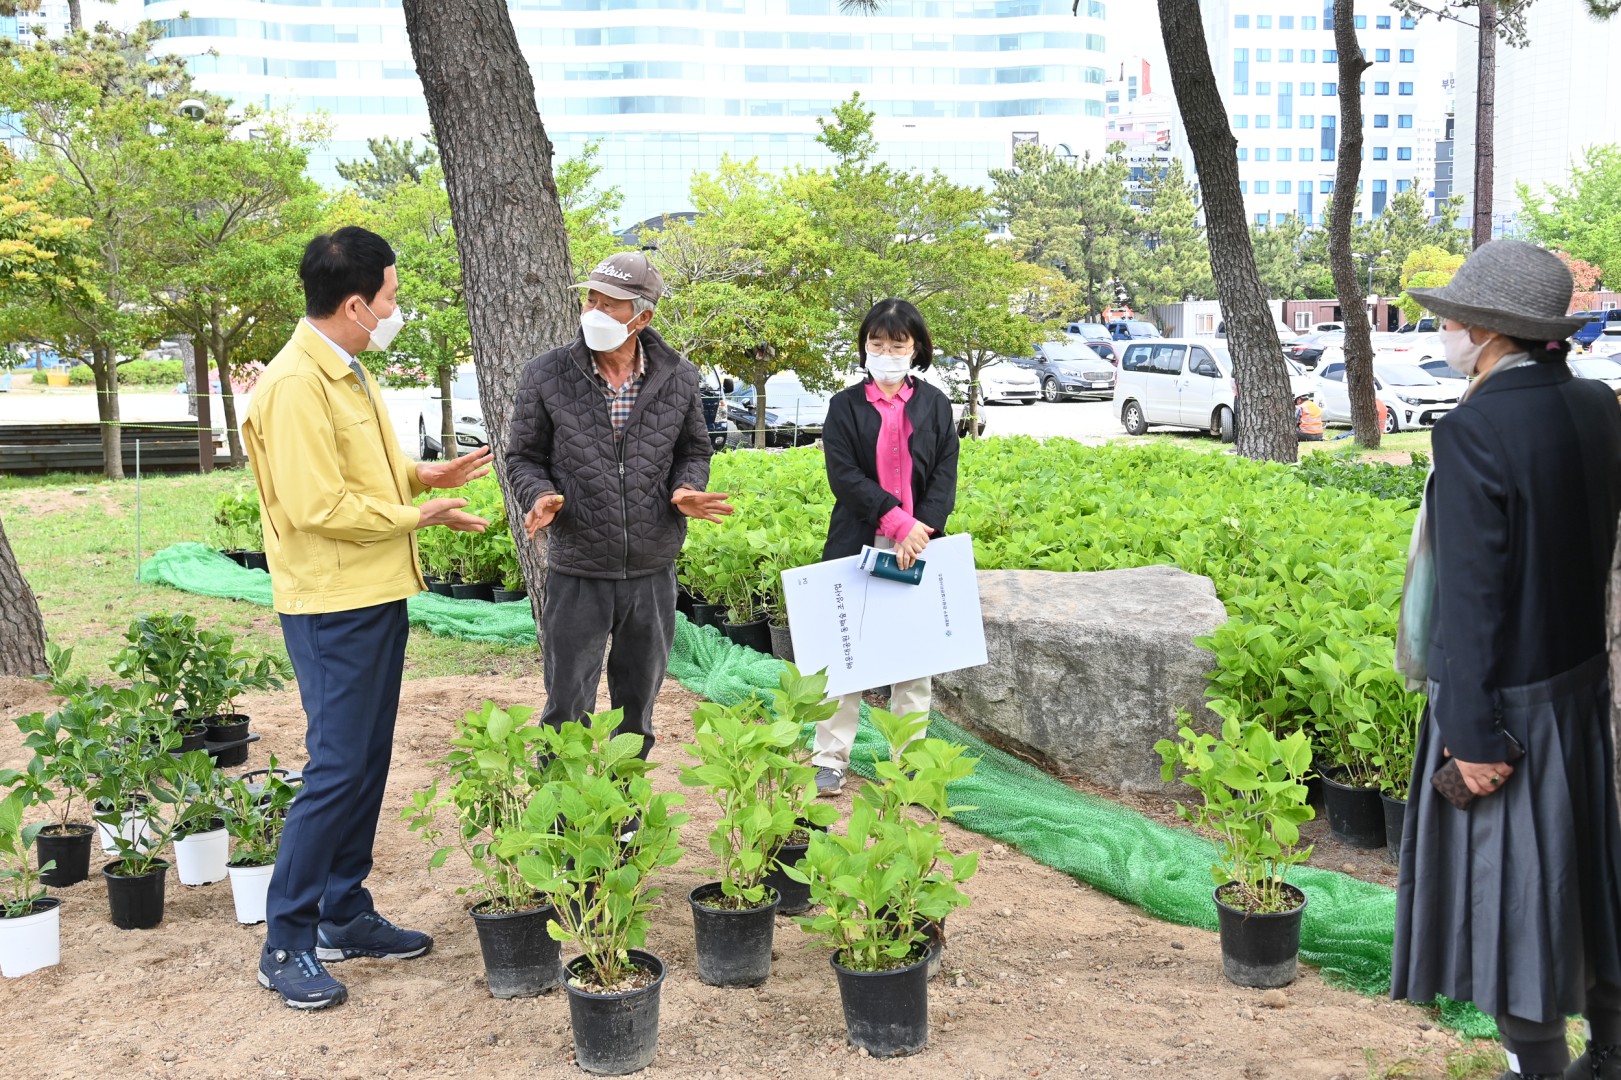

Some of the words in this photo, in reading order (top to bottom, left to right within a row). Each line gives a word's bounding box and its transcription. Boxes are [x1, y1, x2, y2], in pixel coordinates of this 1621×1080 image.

[592, 262, 633, 281] tleist
[834, 583, 845, 610] 조성사업
[839, 613, 848, 633] 동백숲
